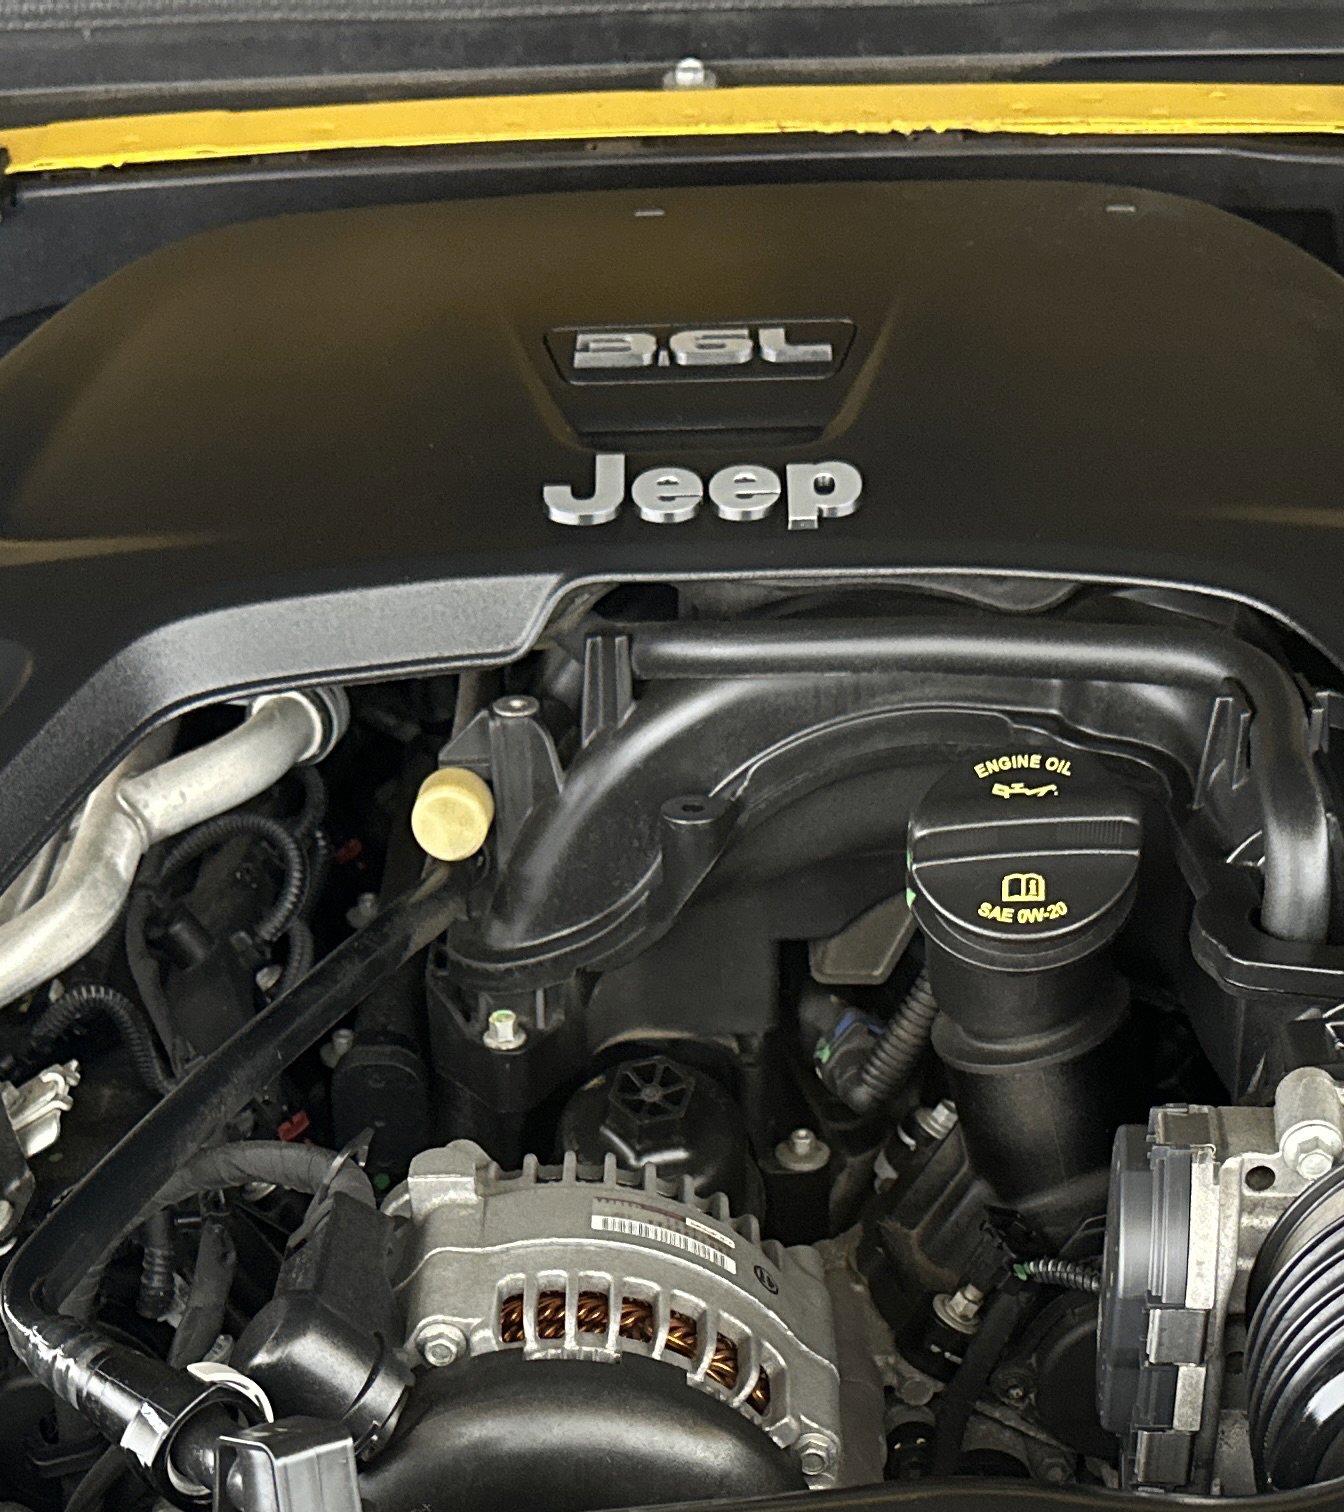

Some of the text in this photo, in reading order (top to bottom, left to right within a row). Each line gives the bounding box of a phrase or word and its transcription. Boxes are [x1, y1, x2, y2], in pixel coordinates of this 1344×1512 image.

[573, 327, 833, 369] 3.6L
[543, 453, 863, 530] Jeep
[973, 754, 1073, 779] ENGINE OIL
[977, 900, 1068, 924] SAE 0W-20
